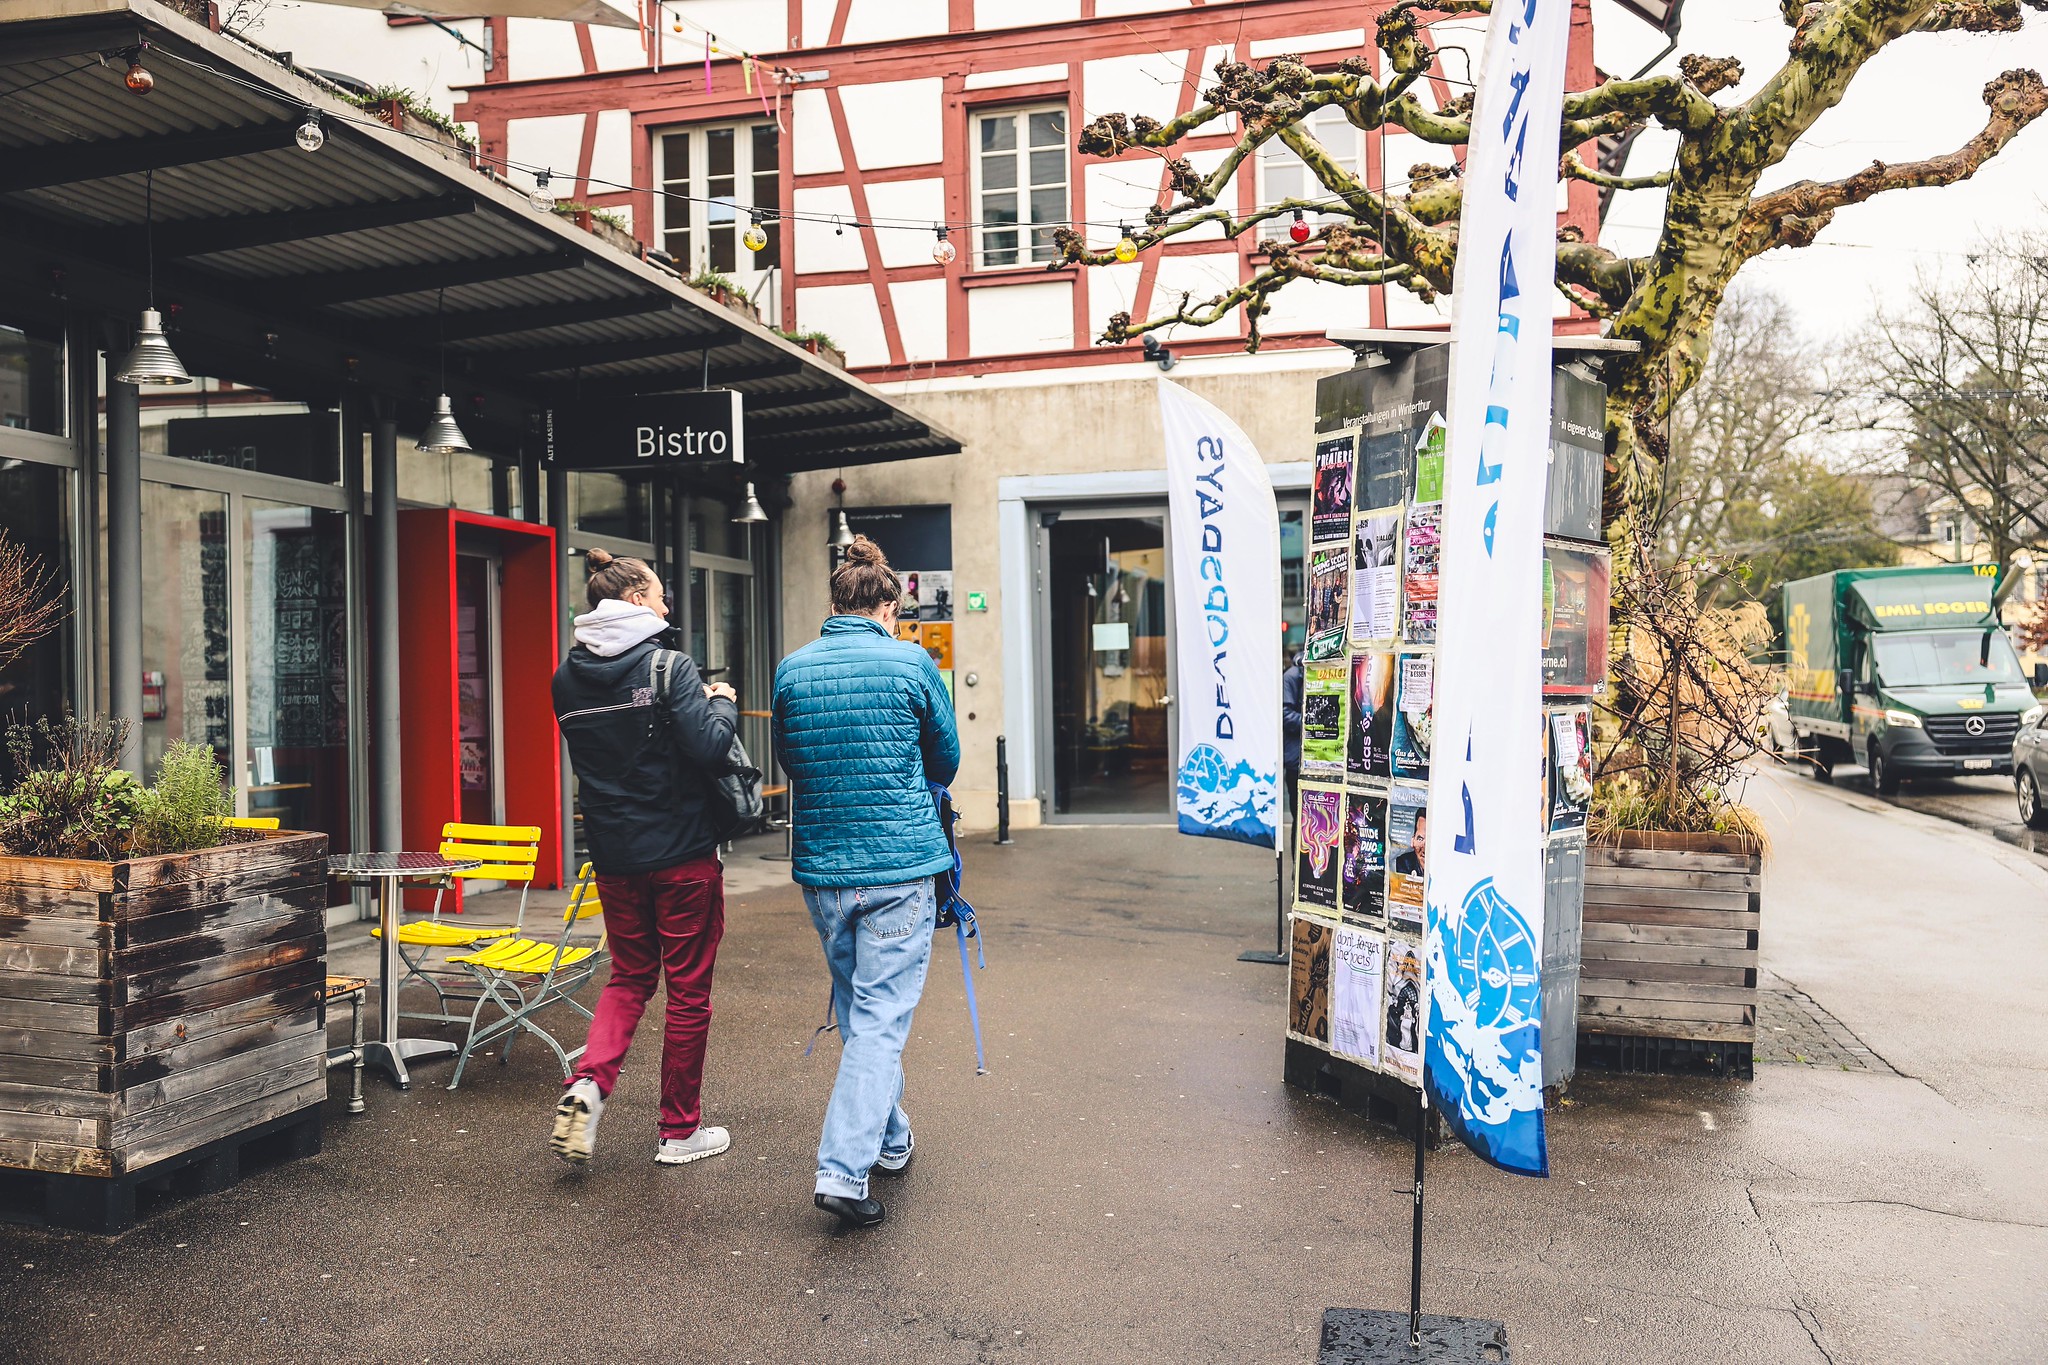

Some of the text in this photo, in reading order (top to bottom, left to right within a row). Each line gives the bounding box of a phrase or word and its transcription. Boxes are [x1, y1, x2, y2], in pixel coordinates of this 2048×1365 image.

[1343, 400, 1431, 428] Veranstaltungen in Winterthur
[546, 409, 554, 442] KASERNE
[1562, 418, 1566, 430] in
[1567, 420, 1586, 436] eigener
[1587, 426, 1603, 441] Sache
[636, 426, 727, 457] Bistro
[1972, 565, 1998, 578] 169
[1875, 601, 1990, 618] EMIL EGGER
[1362, 736, 1372, 770] das
[1394, 748, 1406, 756] Aus
[1336, 946, 1349, 961] the
[1356, 935, 1380, 956] forget
